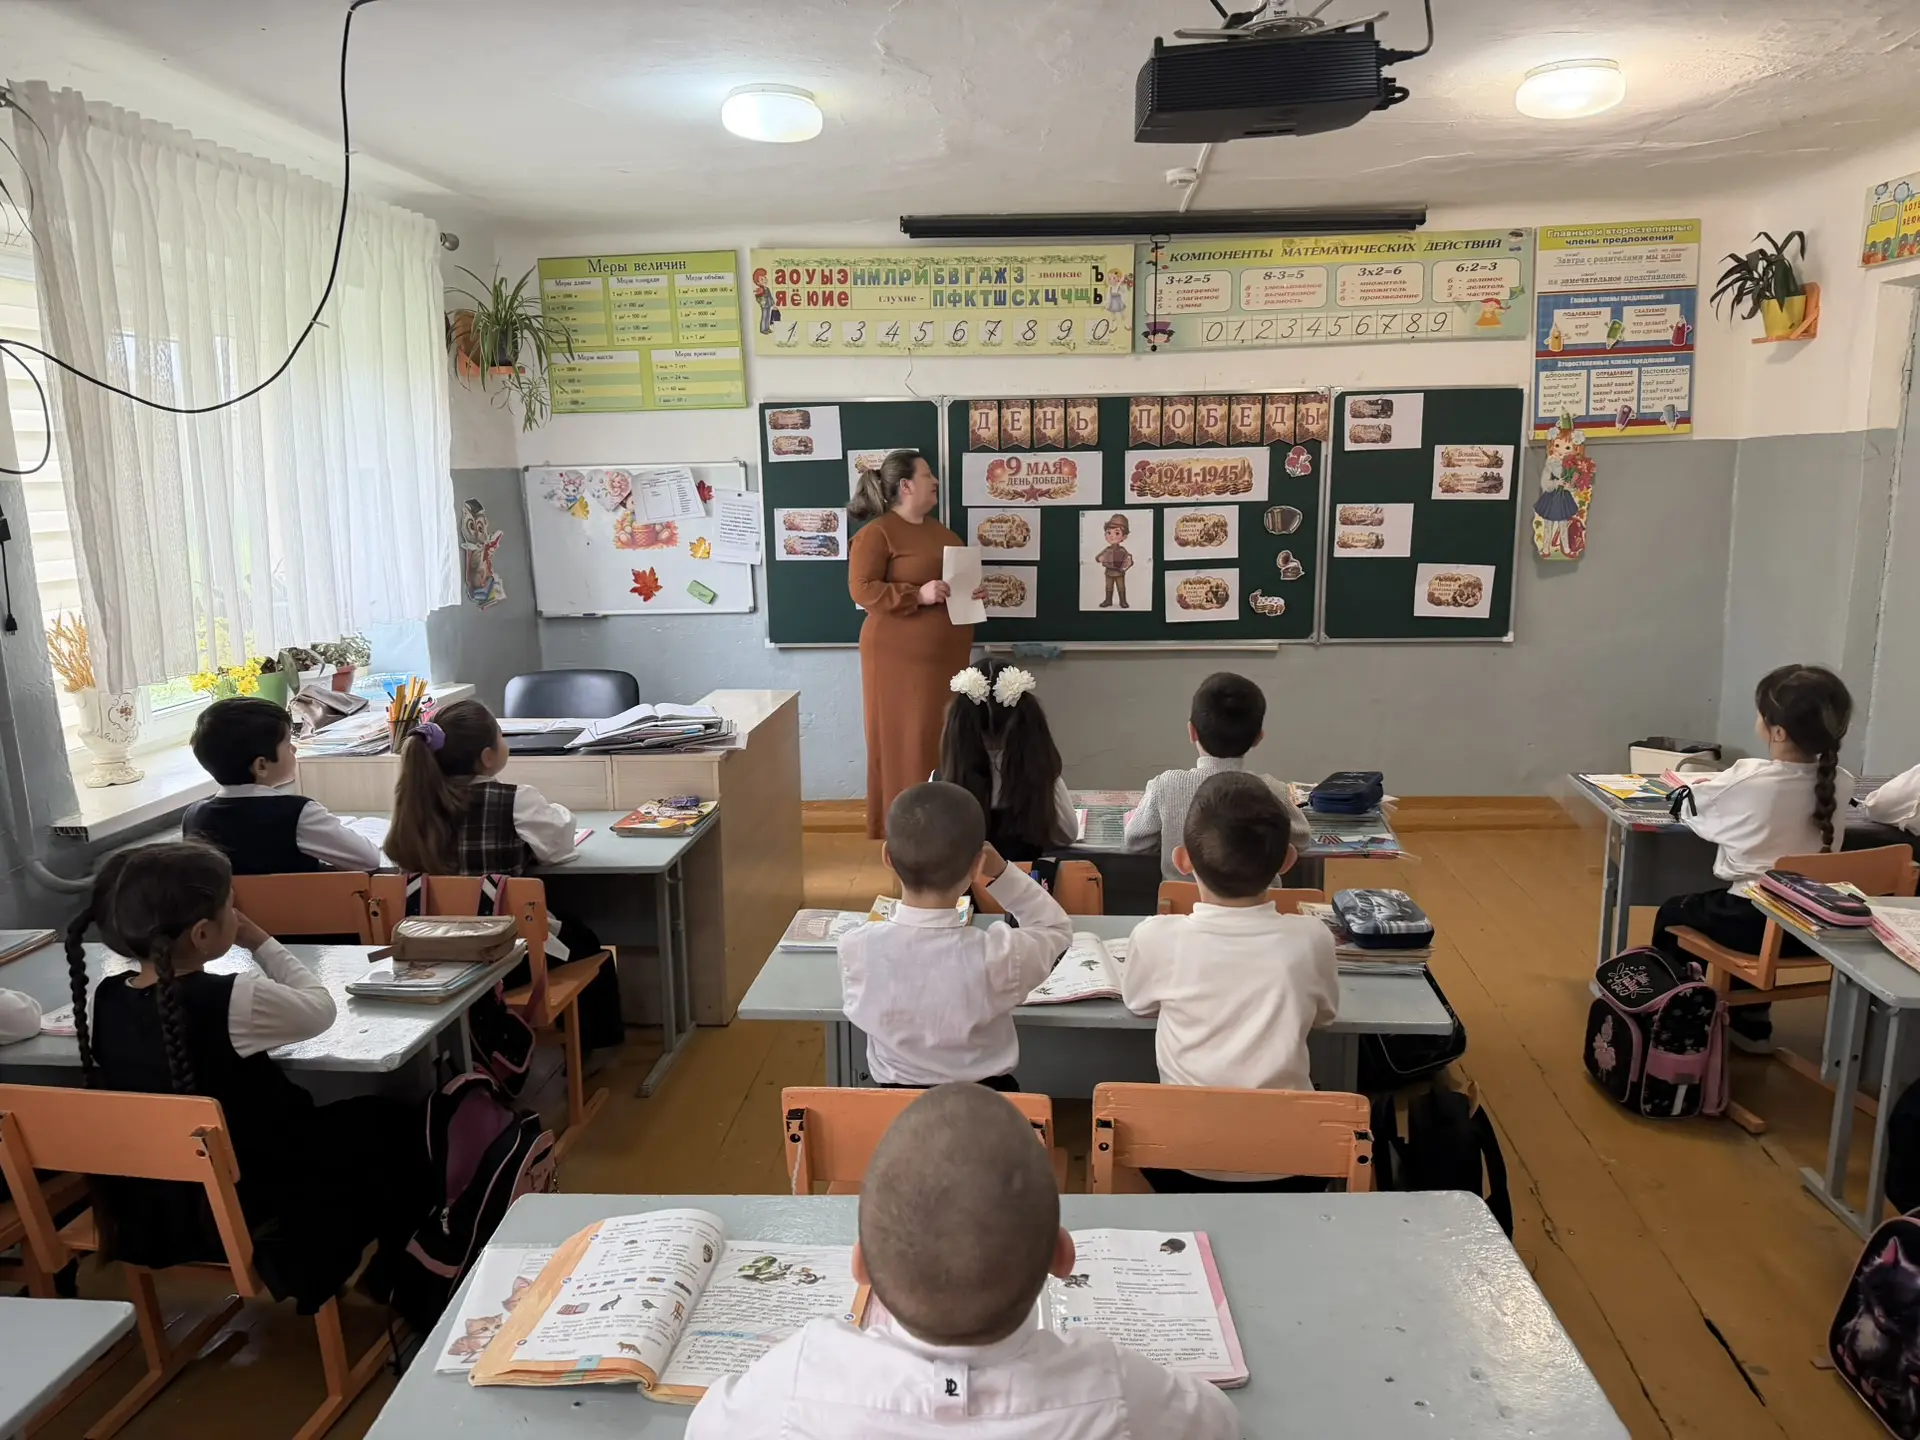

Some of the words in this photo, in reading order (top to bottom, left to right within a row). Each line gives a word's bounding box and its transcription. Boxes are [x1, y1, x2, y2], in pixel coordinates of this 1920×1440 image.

[1547, 228, 1594, 238] Главные
[1606, 224, 1693, 236] второстепенные
[1565, 238, 1599, 246] члены
[1602, 234, 1674, 245] предложения
[1169, 248, 1273, 262] КОМПОНЕНТЫ
[1280, 243, 1416, 258] МАТЕМАТИЧЕСКИХ
[1422, 238, 1502, 252] ДЕЙСТВИЙ
[1556, 256, 1586, 264] Завтра
[1593, 254, 1643, 264] родителями
[588, 258, 628, 276] Меры
[634, 260, 687, 272] величин
[1456, 262, 1498, 272] 6:2=3
[1037, 270, 1083, 280] звонкие
[1165, 274, 1212, 285] 3+2=5
[1262, 270, 1305, 280] 8-3=5
[1560, 275, 1622, 284] замечательное
[1264, 283, 1323, 292] уменьшаемое
[878, 295, 917, 305] глухие
[787, 320, 798, 343] 1
[815, 320, 832, 342] 2
[850, 320, 867, 342] 3
[885, 320, 900, 342] 4
[914, 320, 934, 342] 5
[952, 320, 968, 342] 6
[985, 319, 1002, 341] 7
[1022, 318, 1038, 341] 8
[1056, 318, 1073, 341] 9
[1206, 322, 1223, 342] 0
[1234, 320, 1245, 340] 1
[1255, 319, 1274, 340] 2
[1281, 318, 1298, 338] 3
[1306, 317, 1322, 337] 4
[1328, 316, 1349, 336] 5
[1356, 315, 1372, 335] 6
[1380, 314, 1398, 334] 7
[1406, 312, 1422, 334] 8
[1430, 312, 1448, 332] 9
[976, 410, 1089, 432] ДЕНЬ
[1138, 406, 1320, 430] ПОБЕДЫ
[1005, 456, 1022, 476] 9
[1026, 461, 1064, 476] МАЯ
[1007, 477, 1031, 486] ДЕНЬ
[1032, 476, 1070, 485] ПОБЕДЫ
[1156, 466, 1240, 485] 1941-1945
